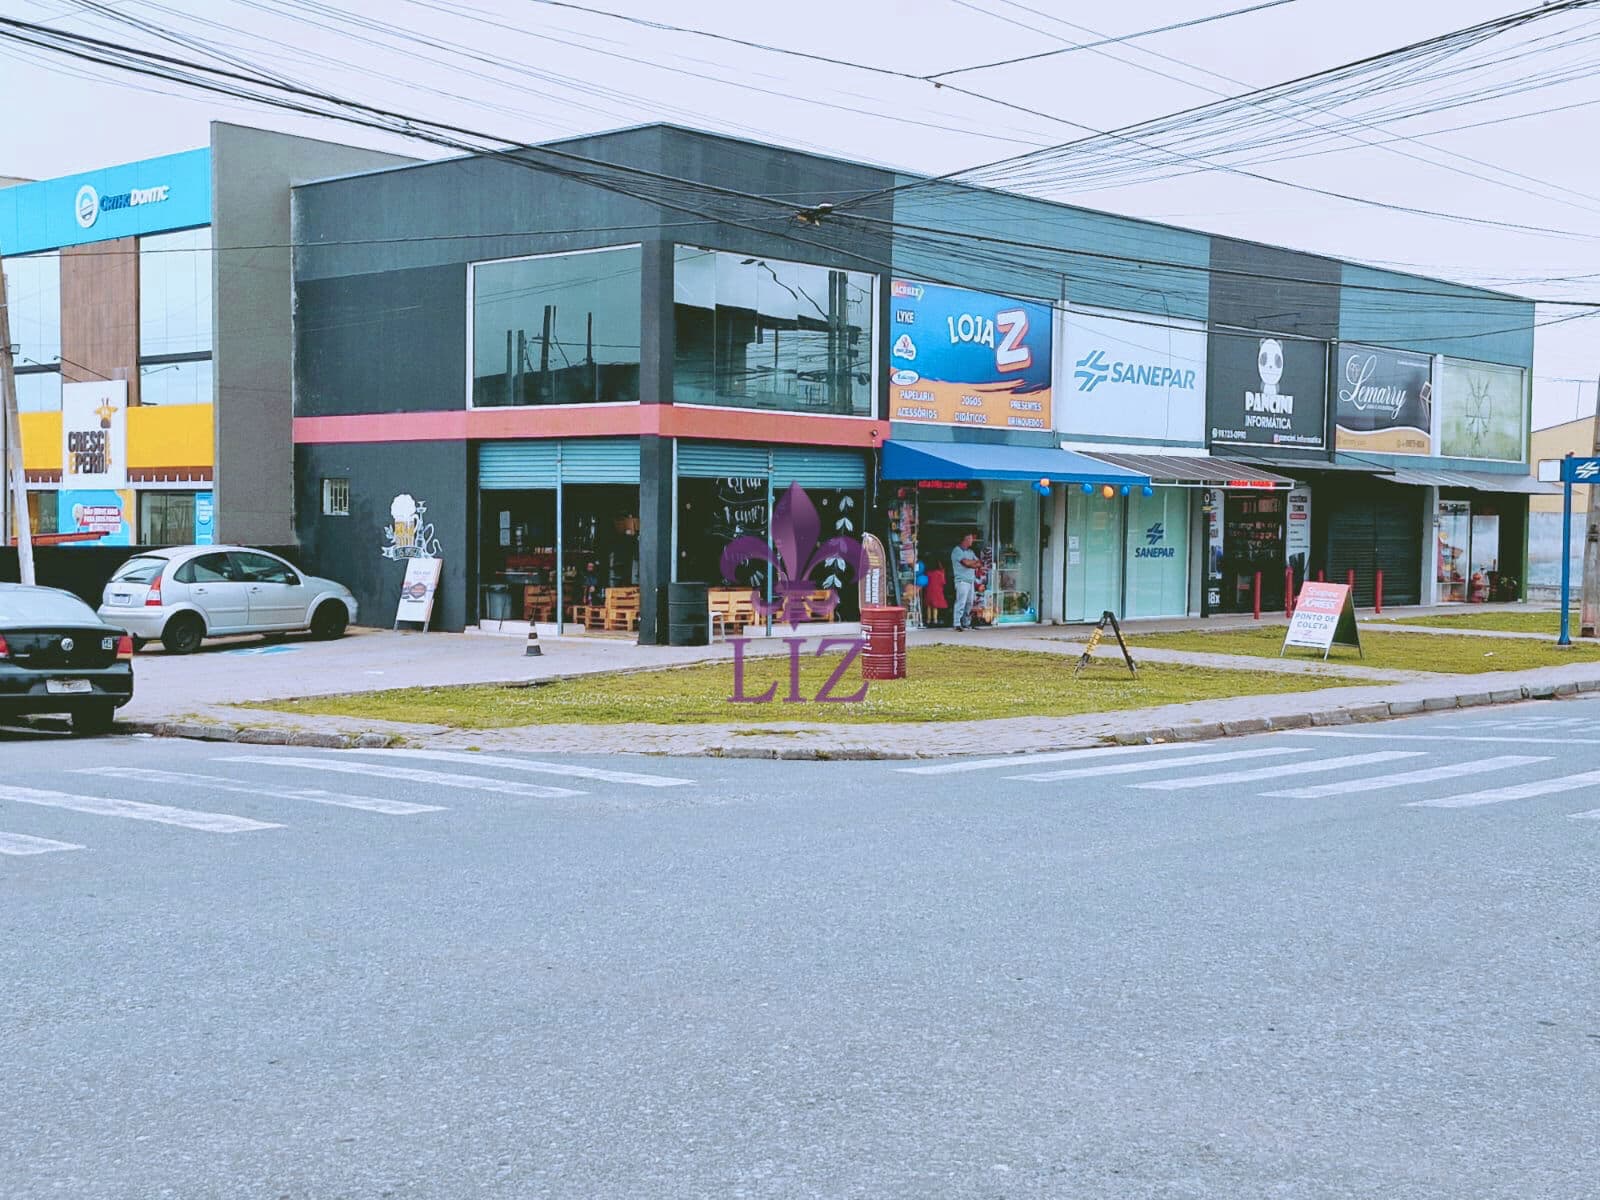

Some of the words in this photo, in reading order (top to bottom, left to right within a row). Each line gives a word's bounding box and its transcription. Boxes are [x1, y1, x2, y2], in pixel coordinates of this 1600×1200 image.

[896, 310, 914, 323] LYKE
[948, 313, 994, 348] LOJA
[996, 308, 1031, 371] Z
[1111, 362, 1195, 390] SANEPAR
[899, 389, 935, 402] PAPELARIA
[961, 394, 983, 406] JOGOS
[1244, 391, 1294, 415] PANCINI
[896, 406, 938, 420] ACESSÓRIOS
[1244, 414, 1292, 430] INFORMÁTICA
[1134, 547, 1175, 558] SANEPAR
[1295, 612, 1323, 621] PONTO
[1296, 621, 1328, 630] COLETA
